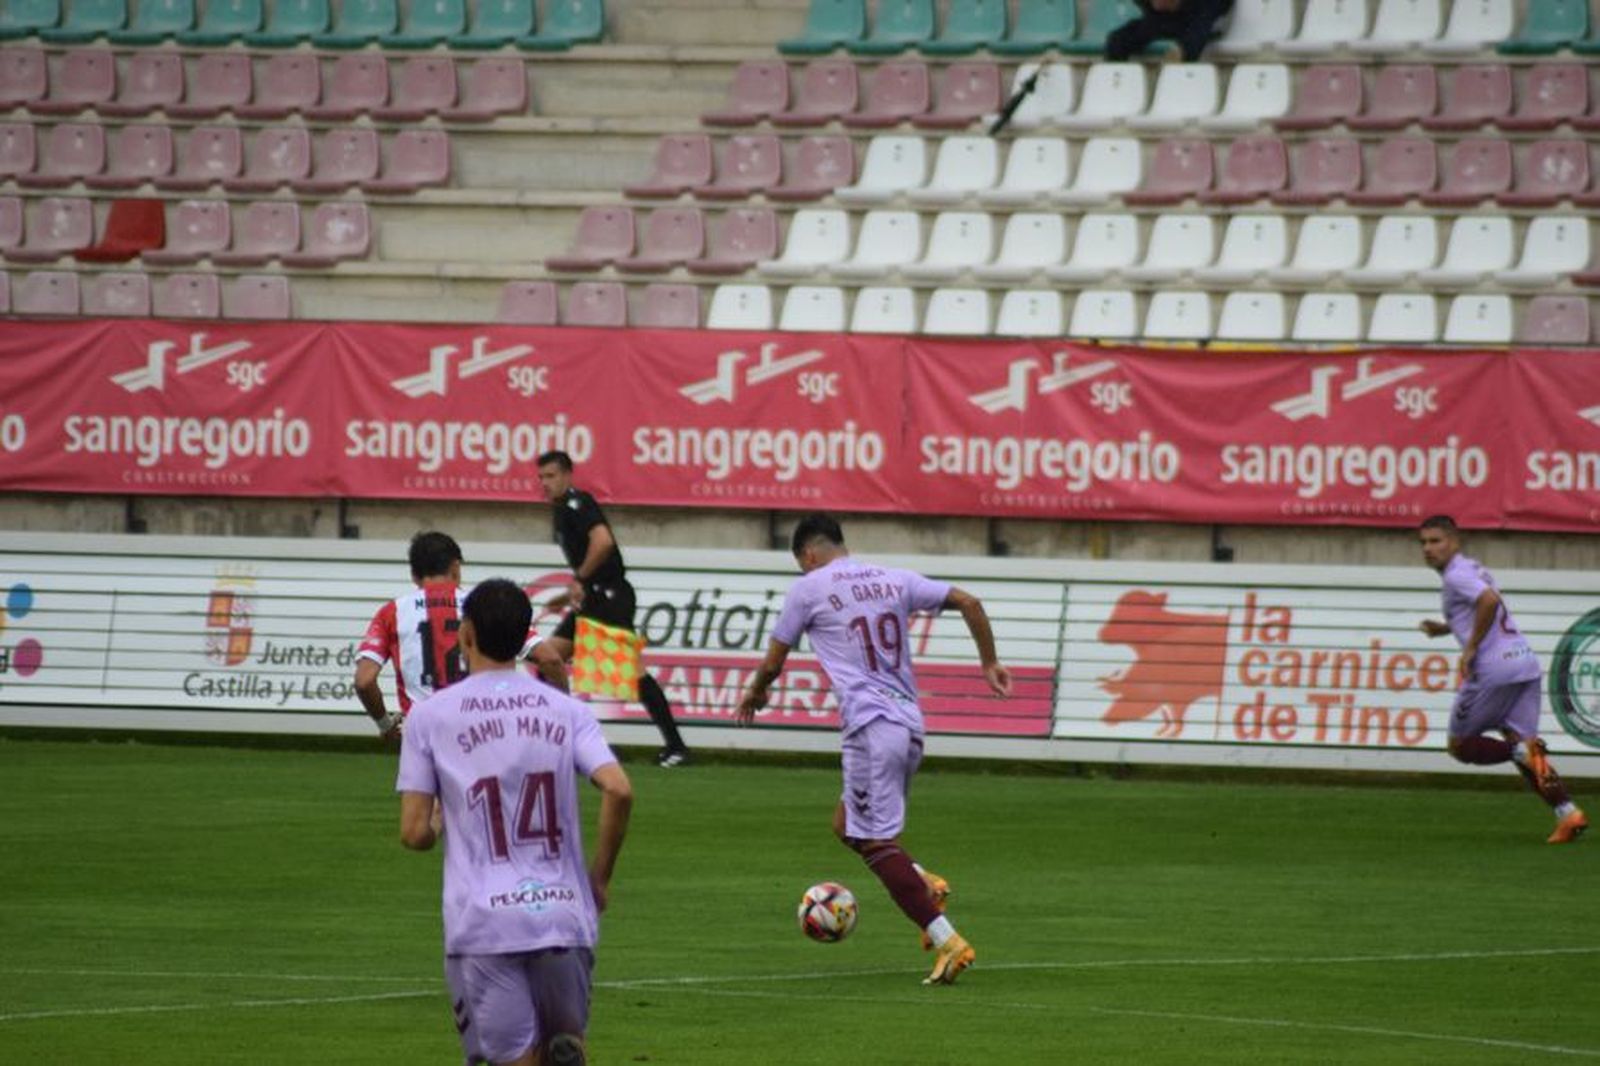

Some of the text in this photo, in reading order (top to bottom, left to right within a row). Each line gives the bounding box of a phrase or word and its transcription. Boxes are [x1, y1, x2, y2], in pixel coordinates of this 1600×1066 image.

[225, 357, 268, 393] sgc
[506, 364, 549, 398] sgc
[797, 369, 840, 404] sgc
[1089, 378, 1133, 415] sgc
[1393, 383, 1438, 420] sgc
[63, 407, 311, 470] sangregorio
[344, 413, 595, 475] sangregorio
[632, 420, 885, 482] sangregorio
[919, 430, 1181, 492] sangregorio
[1220, 435, 1489, 500] sangregorio
[851, 582, 904, 602] GARAY
[1241, 592, 1293, 643] la
[256, 641, 357, 667] Junta d
[849, 611, 903, 673] 19
[183, 672, 273, 699] Castilla
[277, 680, 295, 706] y
[642, 664, 840, 718] AMOR
[456, 716, 567, 754] SAMU MAYO
[1233, 690, 1430, 746] de Tino
[465, 770, 564, 866] 14
